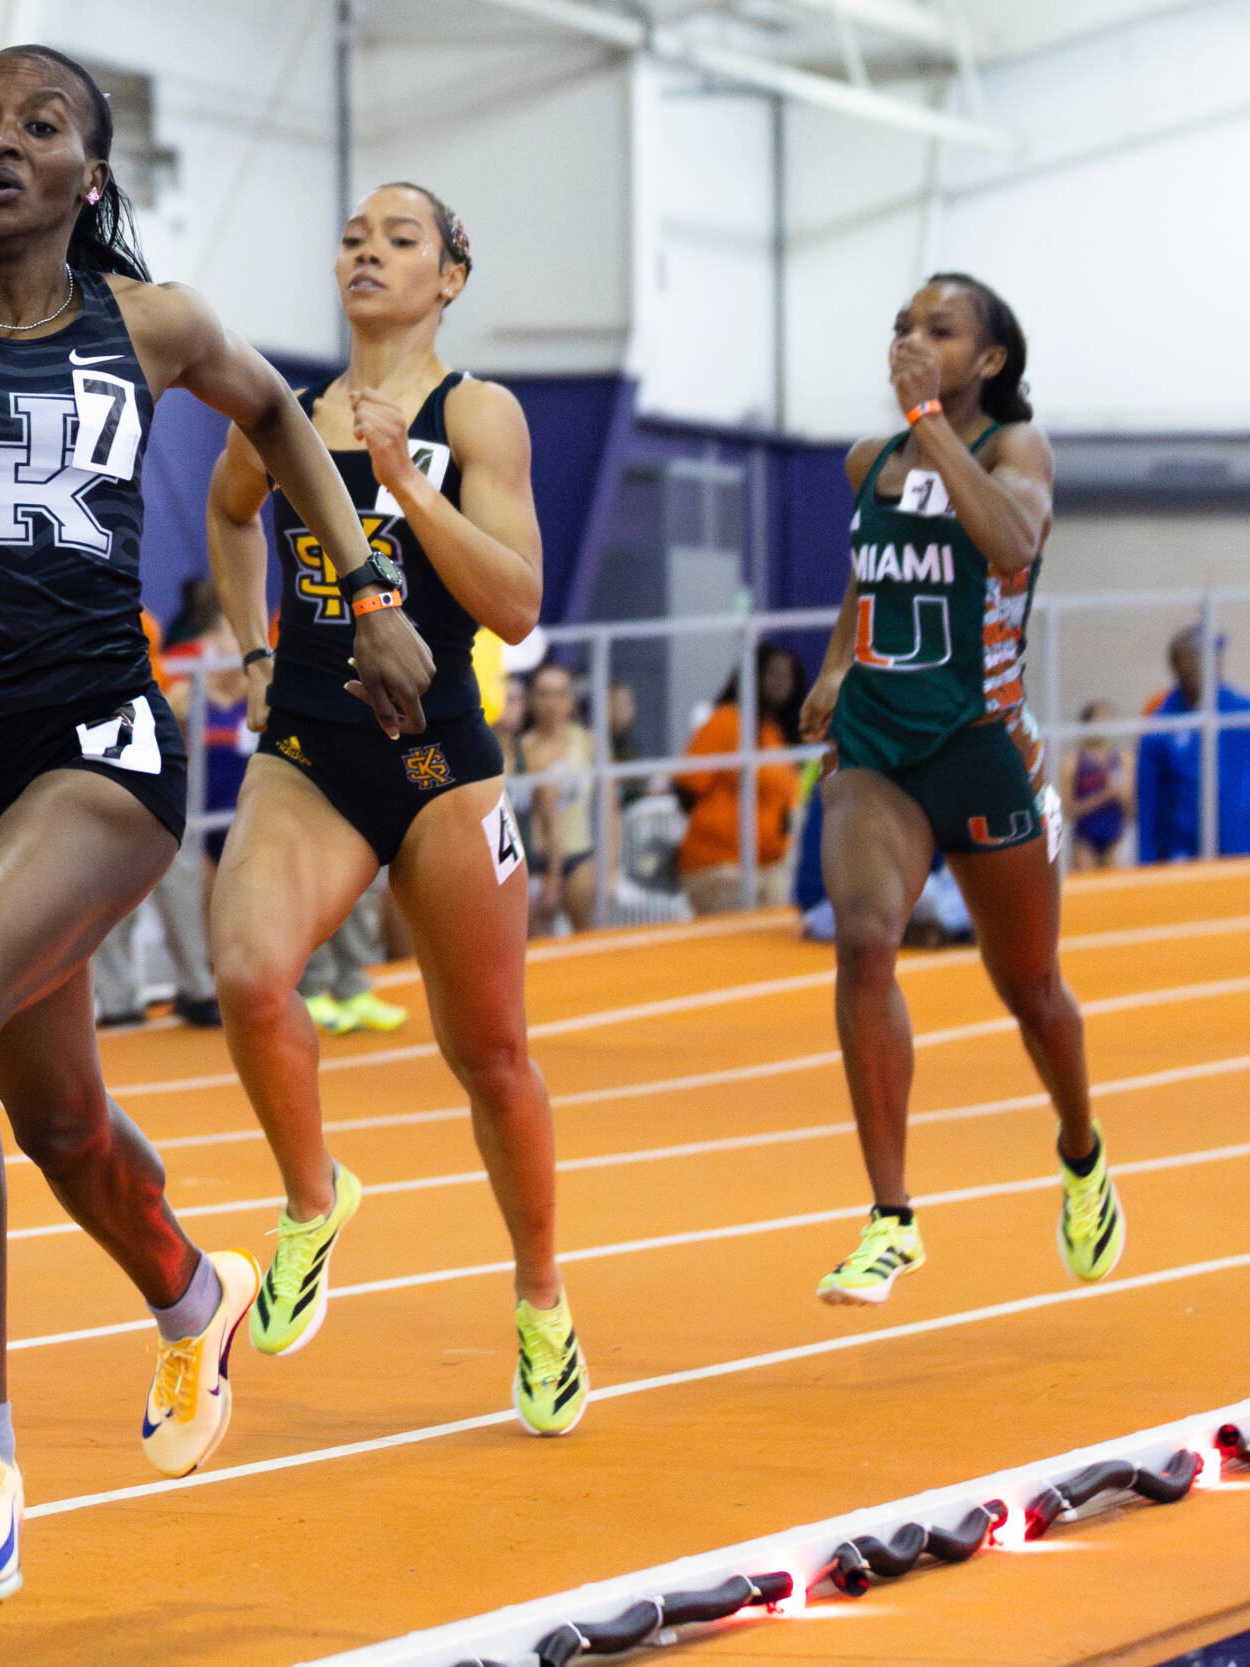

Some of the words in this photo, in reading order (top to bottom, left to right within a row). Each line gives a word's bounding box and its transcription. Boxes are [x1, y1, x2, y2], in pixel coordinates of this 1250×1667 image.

[82, 378, 127, 466] 7
[850, 542, 955, 583] MIAMI
[854, 594, 952, 671] U
[498, 807, 519, 864] 4
